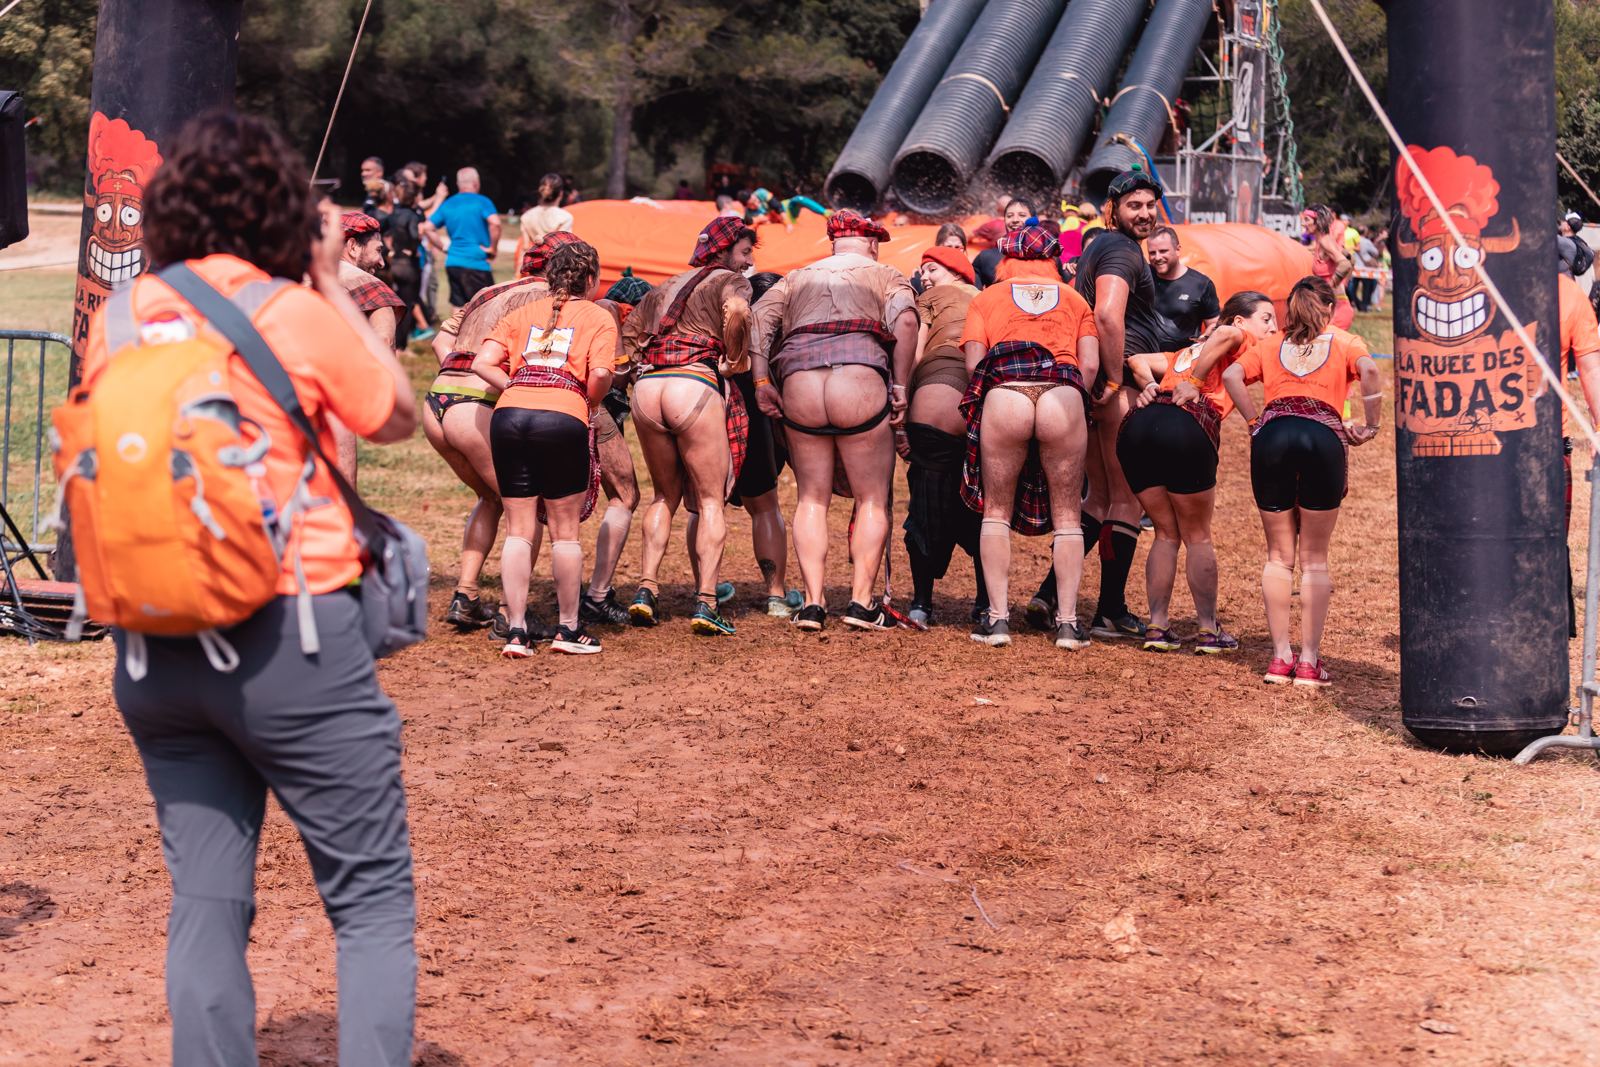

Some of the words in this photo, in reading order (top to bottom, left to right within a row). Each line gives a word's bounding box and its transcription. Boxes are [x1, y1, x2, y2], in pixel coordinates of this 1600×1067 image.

[1399, 351, 1416, 373] LA
[1483, 345, 1525, 372] DES
[1400, 372, 1525, 419] FADAS
